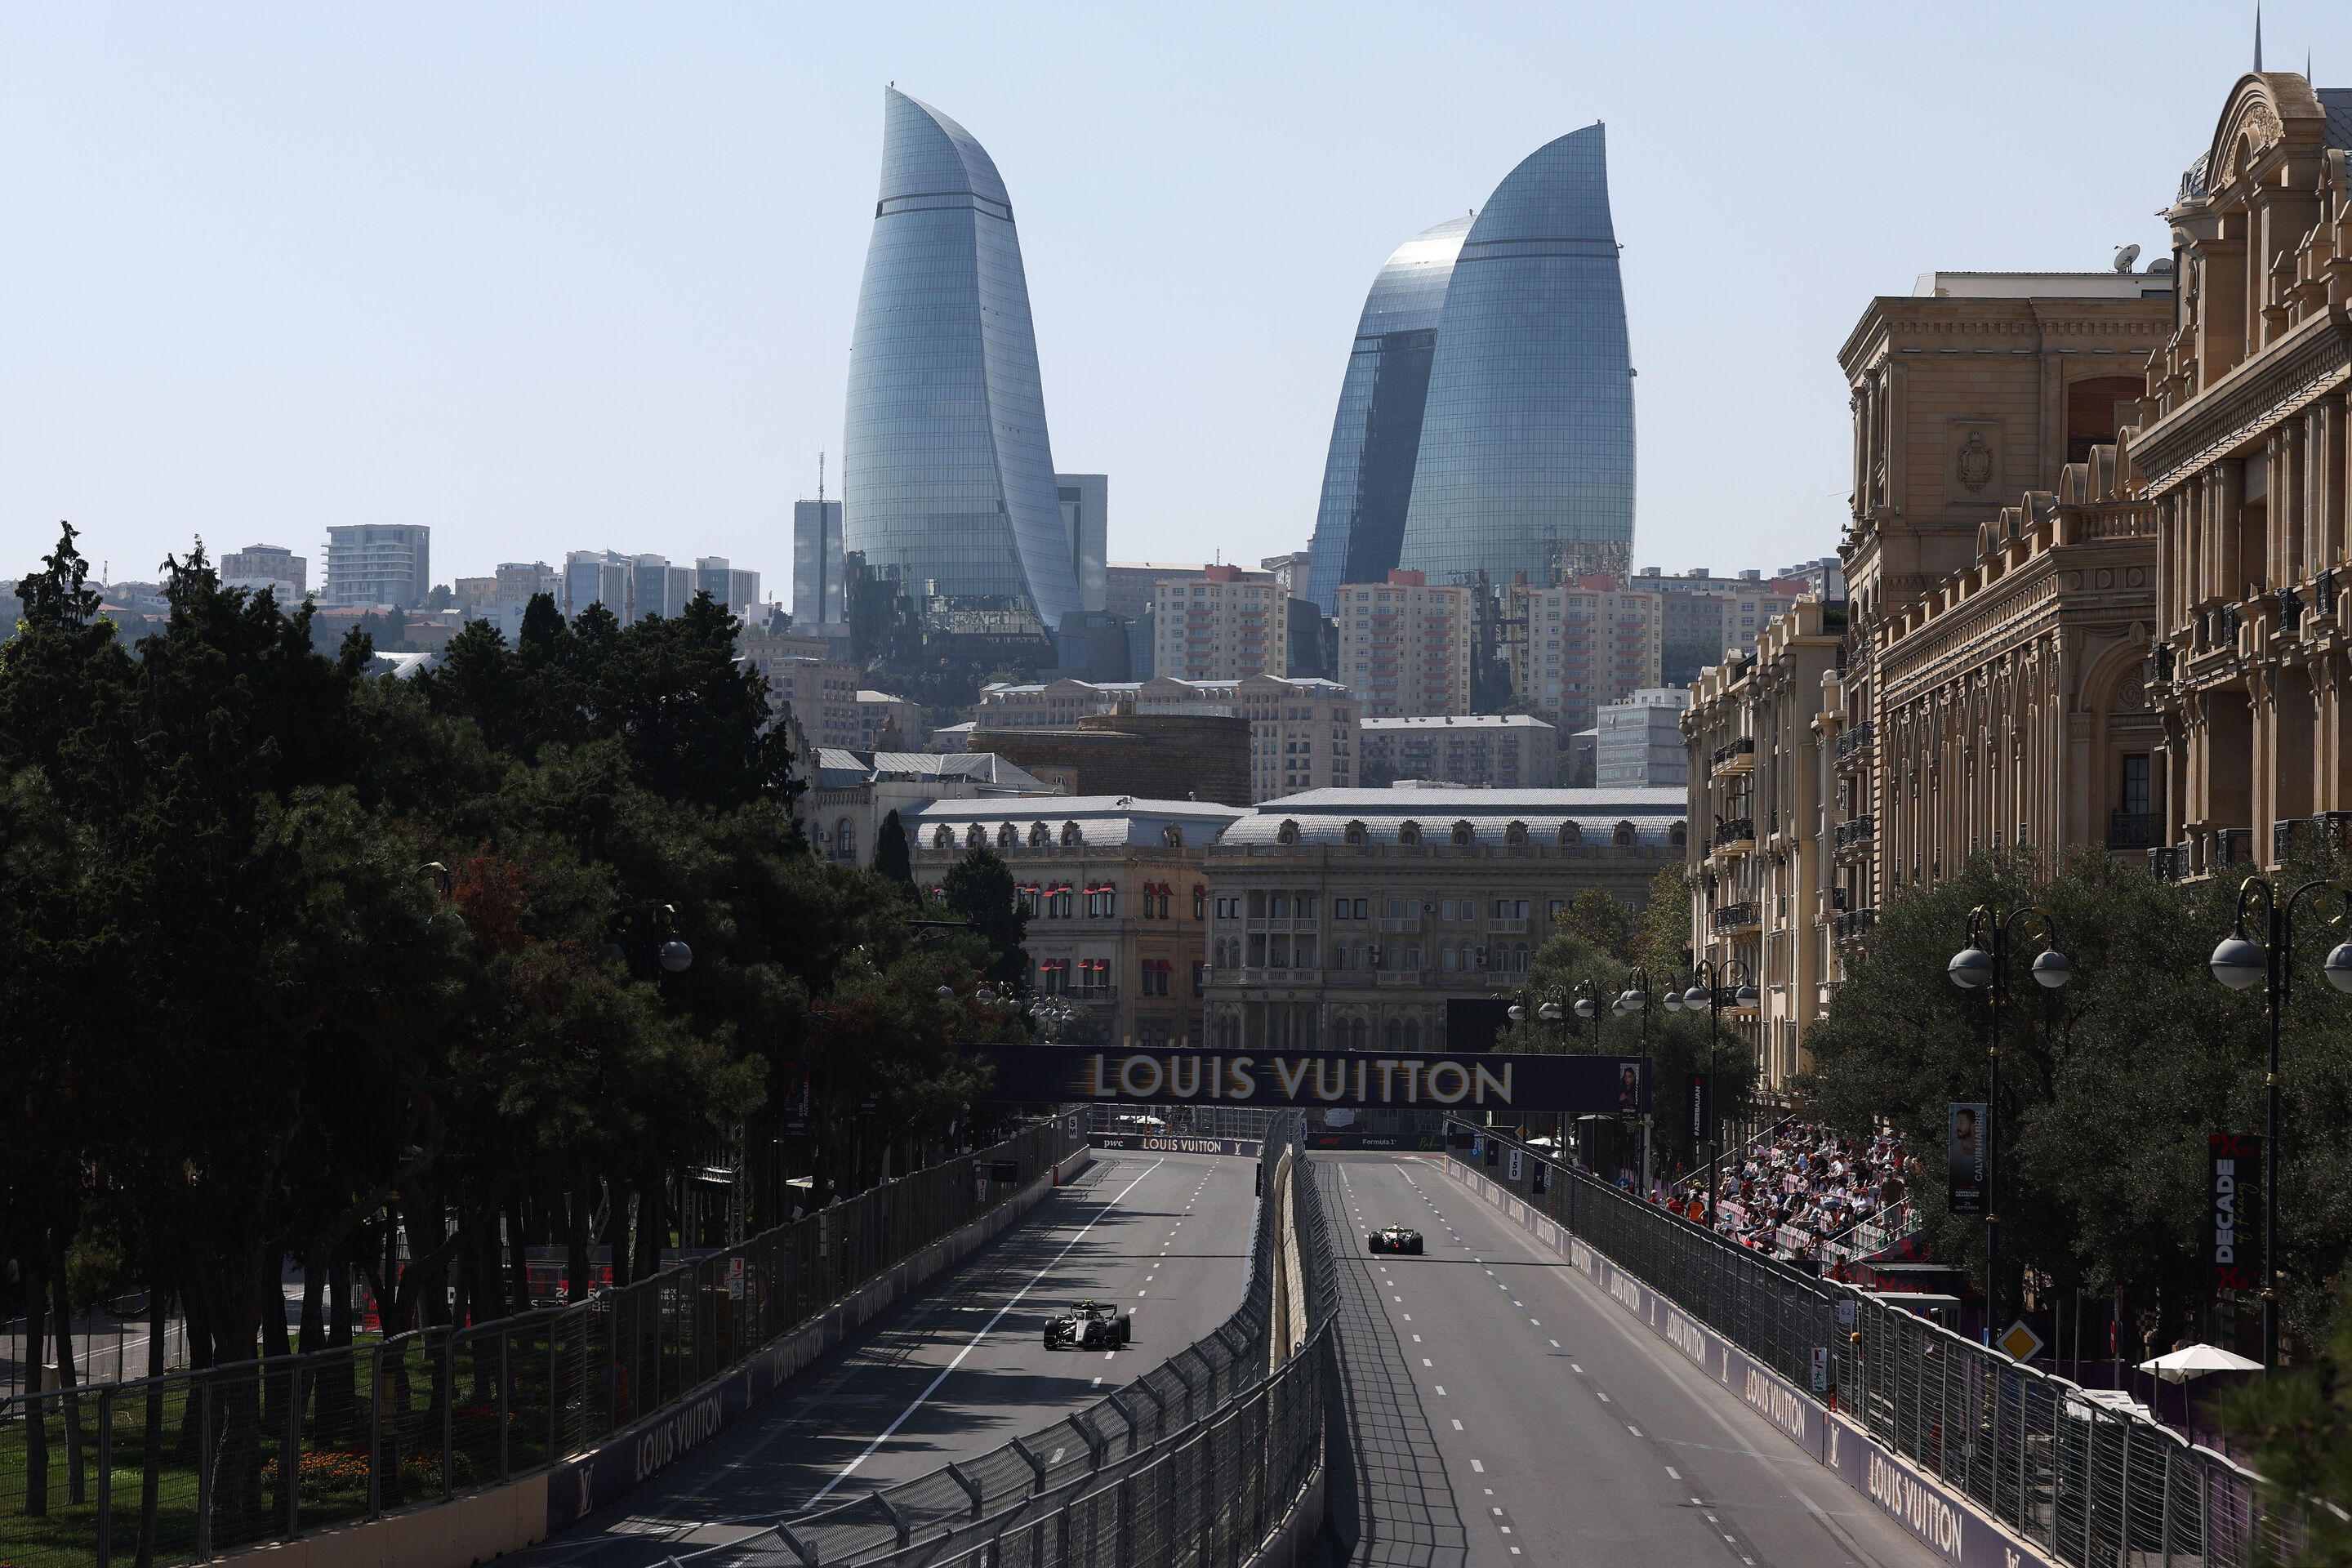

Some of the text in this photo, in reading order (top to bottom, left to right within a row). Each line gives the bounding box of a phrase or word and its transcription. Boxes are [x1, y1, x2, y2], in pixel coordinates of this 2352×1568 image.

[1095, 1054, 1512, 1105] LOUIS VUITTON
[1103, 1139, 1124, 1148] pwc
[1143, 1138, 1222, 1153] LOUIS VUITTON
[1975, 1111, 1983, 1182] CALVIN HARRIS
[2216, 1159, 2235, 1263] DECADE
[1667, 1308, 1706, 1365] LOUIS VUITTON
[1841, 1307, 1851, 1316] 6.2
[1746, 1366, 1806, 1441] LOUIS VUITTON
[635, 1391, 723, 1483] LOUIS VUITTON
[1869, 1451, 1962, 1562] LOUIS VUITTON
